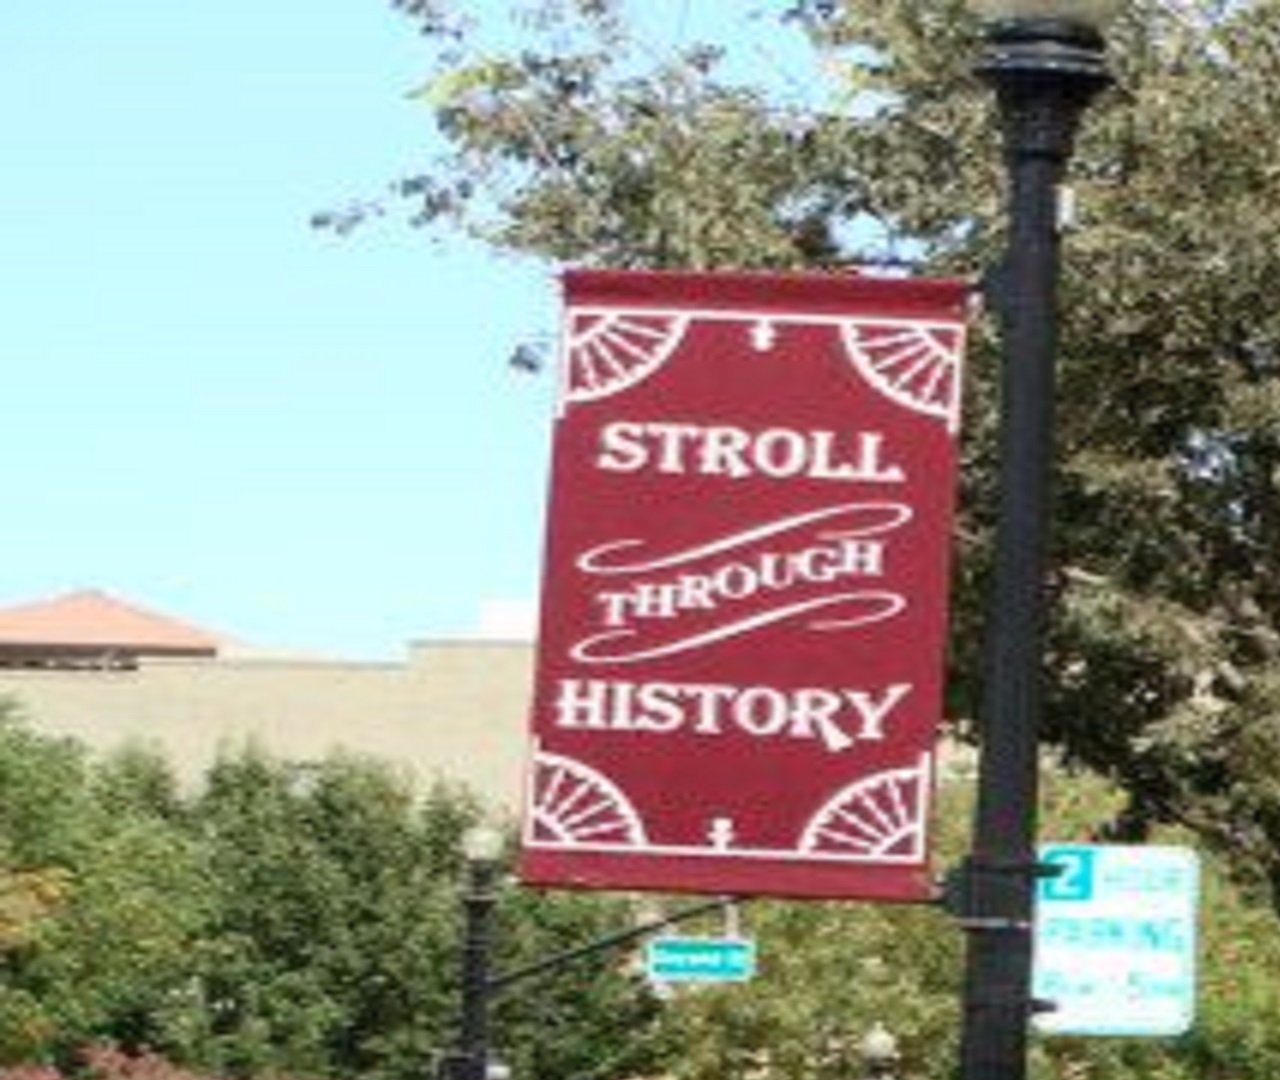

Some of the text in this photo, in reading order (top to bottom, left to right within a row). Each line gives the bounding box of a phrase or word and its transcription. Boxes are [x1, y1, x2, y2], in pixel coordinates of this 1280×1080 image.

[596, 421, 906, 482] STROLL
[597, 540, 883, 627] THROUGH
[555, 678, 912, 752] HISTORY
[1048, 851, 1084, 896] 2
